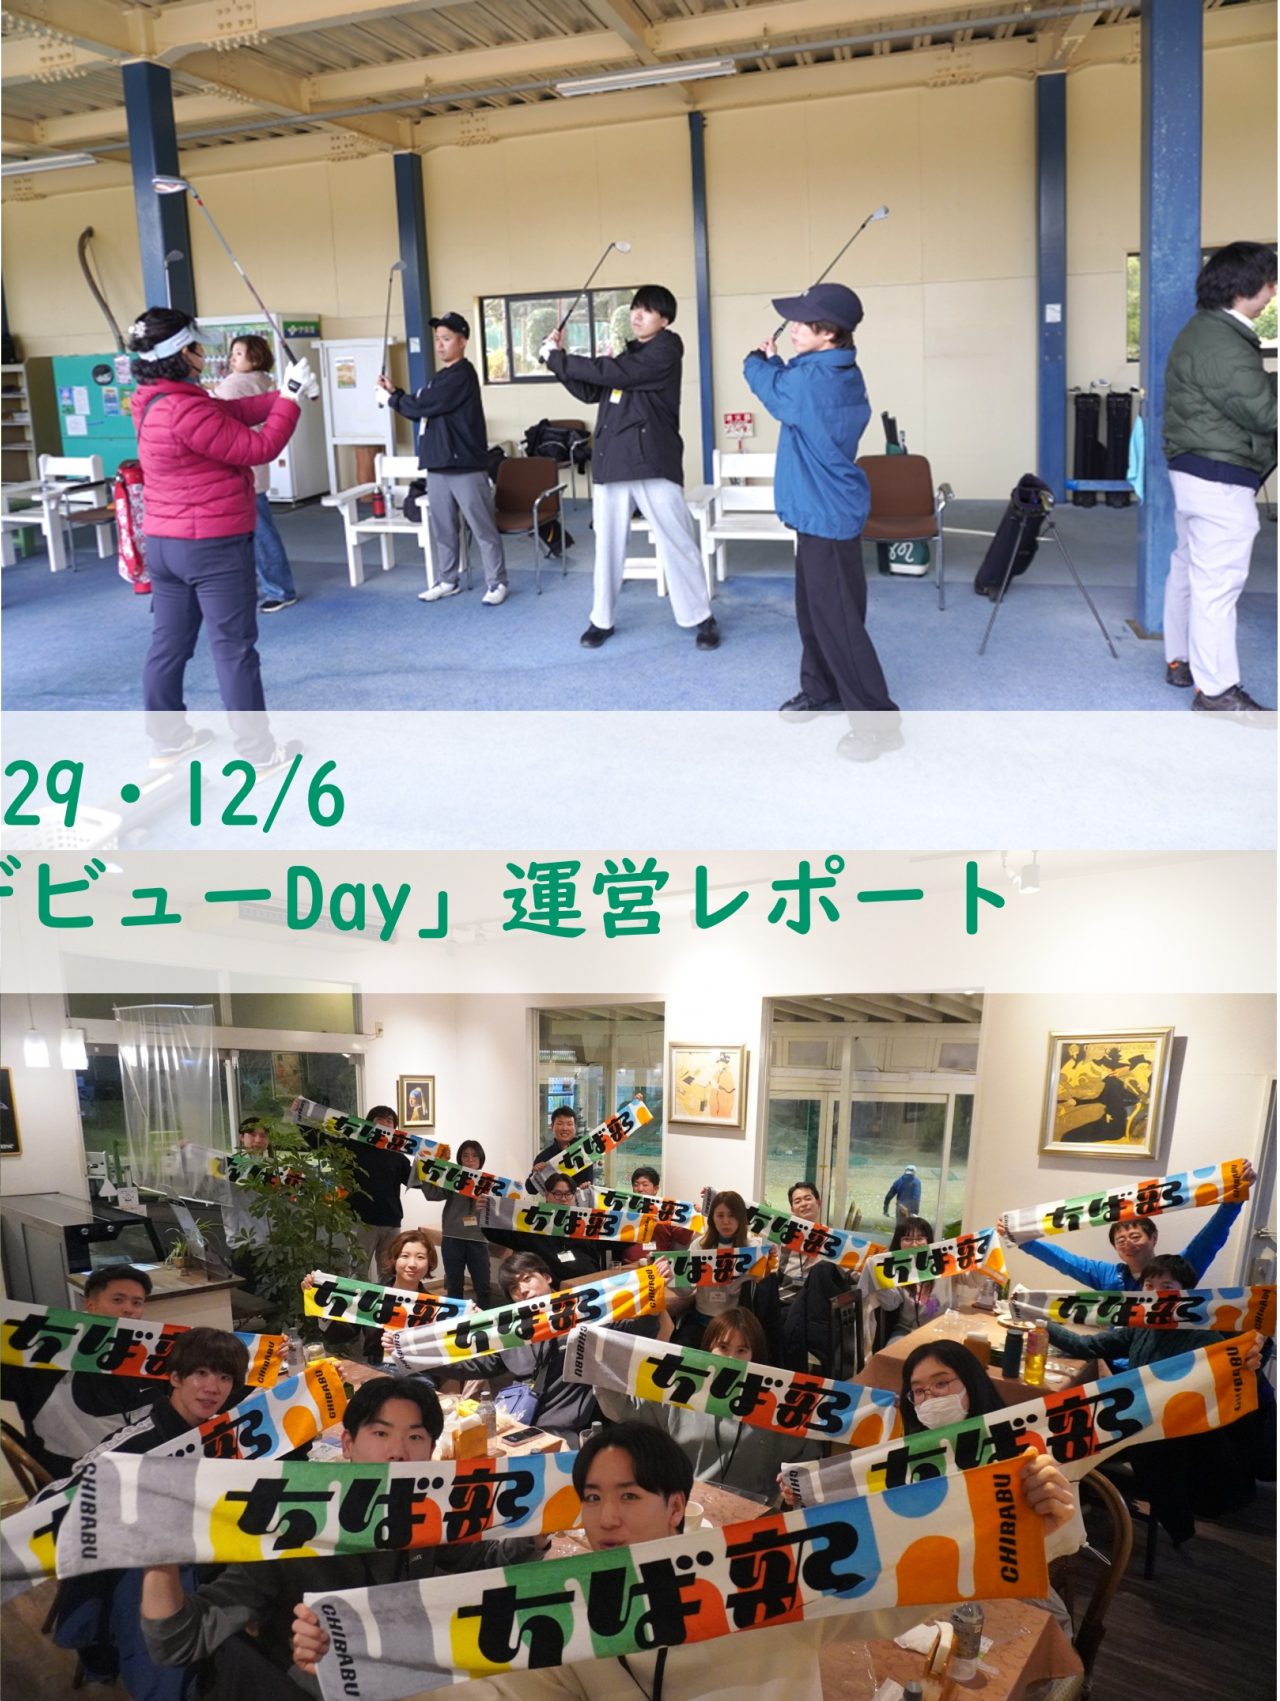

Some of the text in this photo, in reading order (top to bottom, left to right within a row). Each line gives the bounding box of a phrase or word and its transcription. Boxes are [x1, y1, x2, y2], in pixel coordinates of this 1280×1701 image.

[558, 1110, 635, 1170] ちば部
[521, 1205, 618, 1237] ちば部
[1045, 1180, 1184, 1231] ちば部
[447, 1288, 600, 1353] ちば部
[574, 1325, 588, 1378] CHIBABU
[315, 1369, 337, 1420] CHIBABU
[646, 1353, 851, 1433] ちば部
[78, 1462, 98, 1560] CHIBABU
[225, 1468, 535, 1551] ちば部
[1000, 1472, 1020, 1585] CHIBABU
[458, 1520, 867, 1667] ちば部
[321, 1604, 360, 1697] CHIBABU
